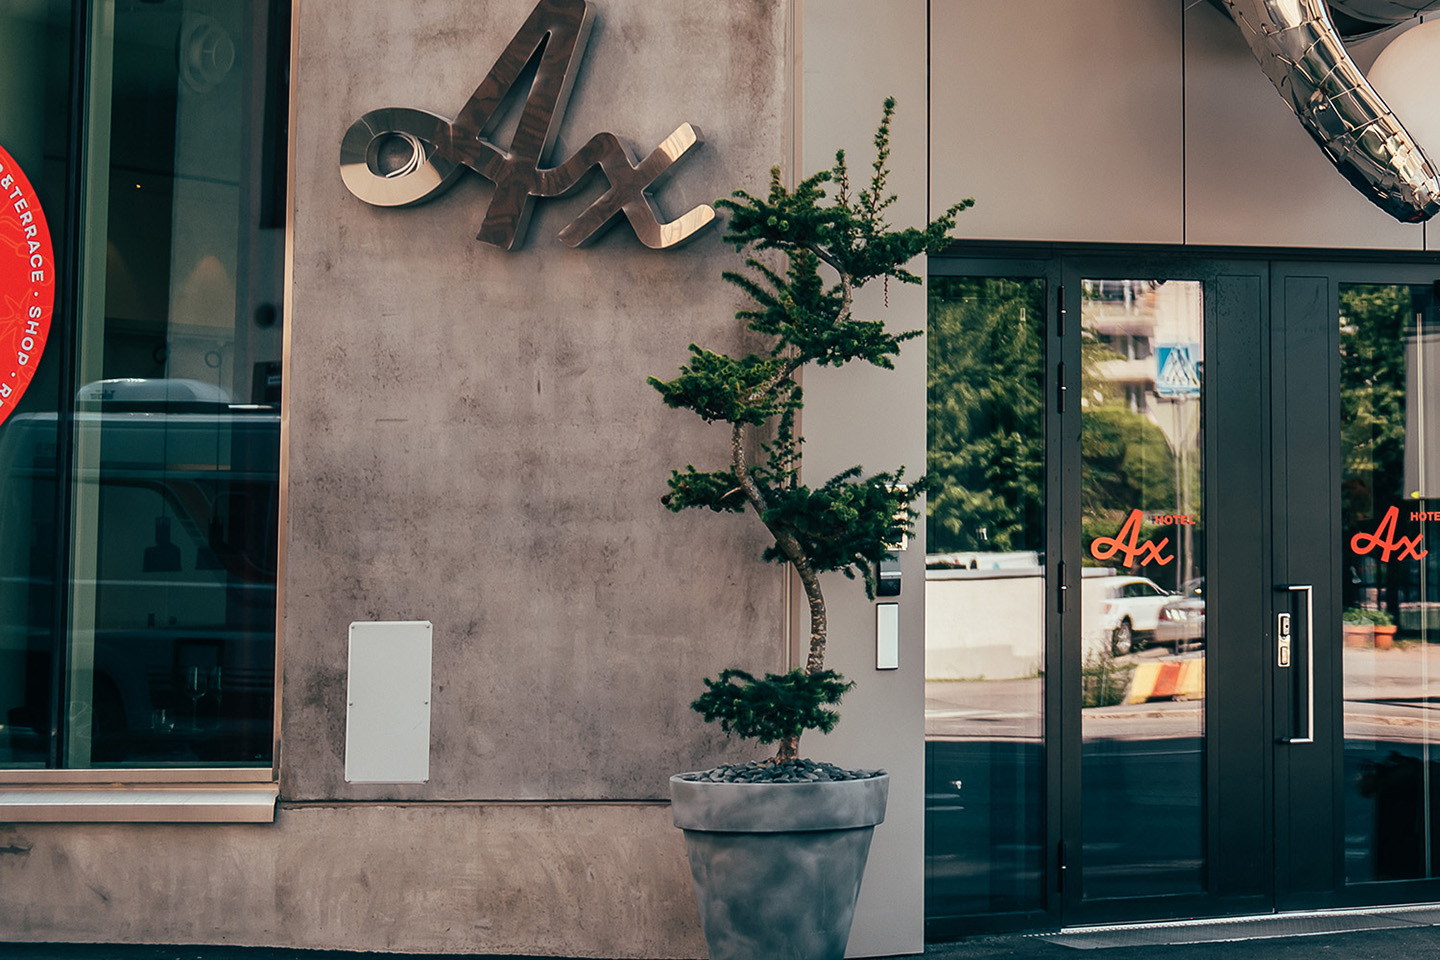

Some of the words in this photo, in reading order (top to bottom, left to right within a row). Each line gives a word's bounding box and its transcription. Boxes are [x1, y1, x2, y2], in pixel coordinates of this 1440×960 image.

[18, 306, 42, 366] SHOP
[1090, 508, 1174, 568] Ax
[1154, 514, 1196, 526] HOTEL
[1350, 505, 1428, 563] Ax
